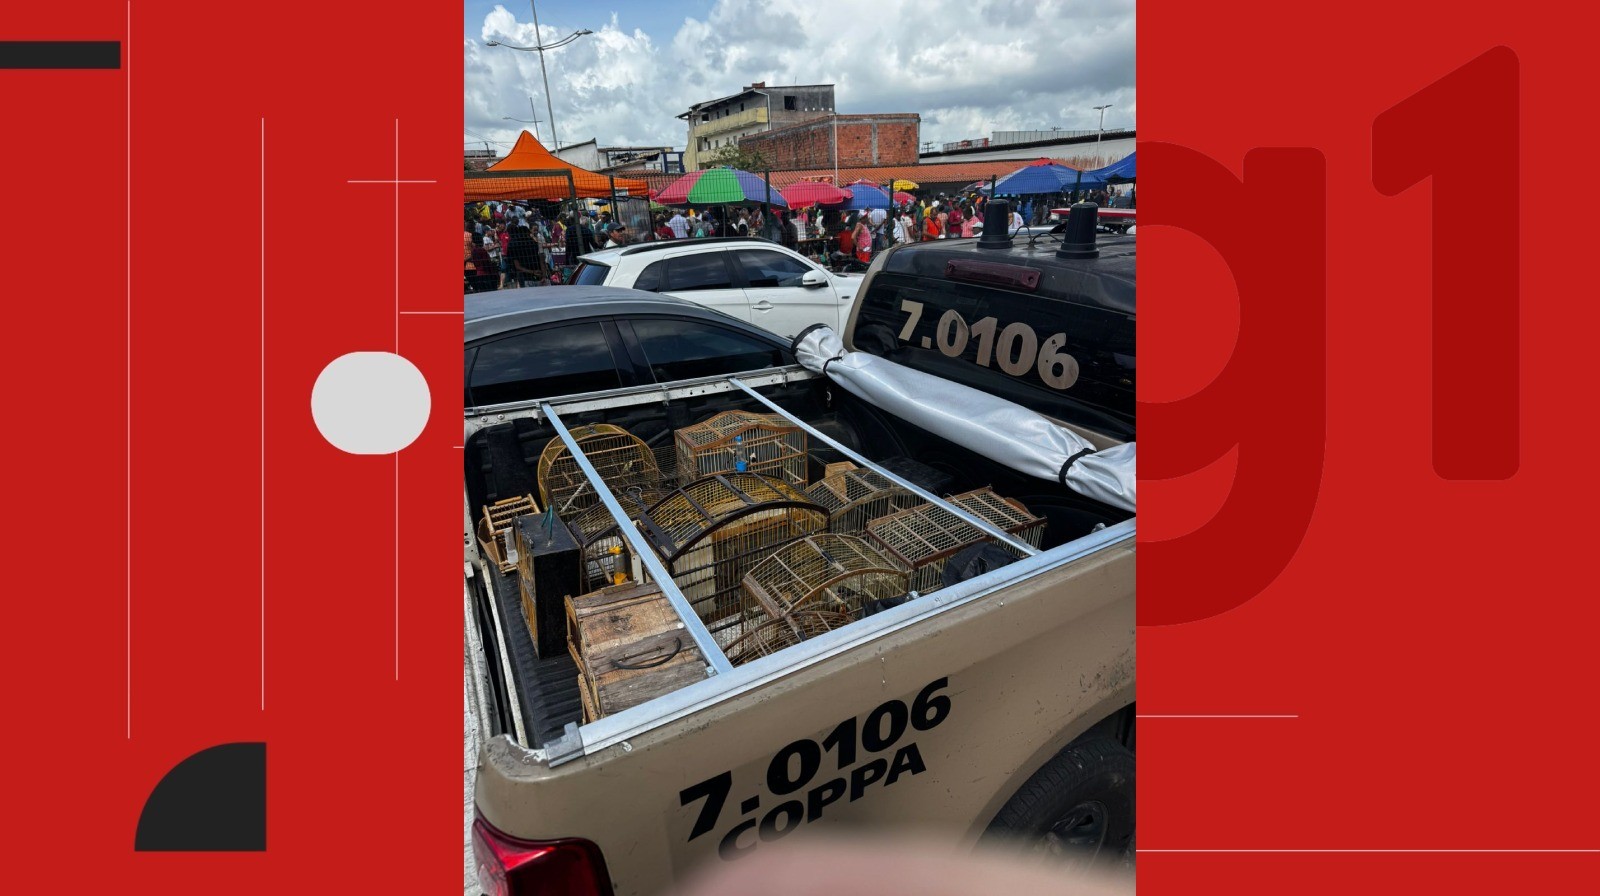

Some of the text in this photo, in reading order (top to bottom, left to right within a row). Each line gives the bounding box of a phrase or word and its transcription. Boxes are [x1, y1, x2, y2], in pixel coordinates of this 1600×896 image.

[899, 299, 1079, 390] 7.0106
[679, 676, 951, 842] 7.0106
[718, 742, 927, 862] COPPA
